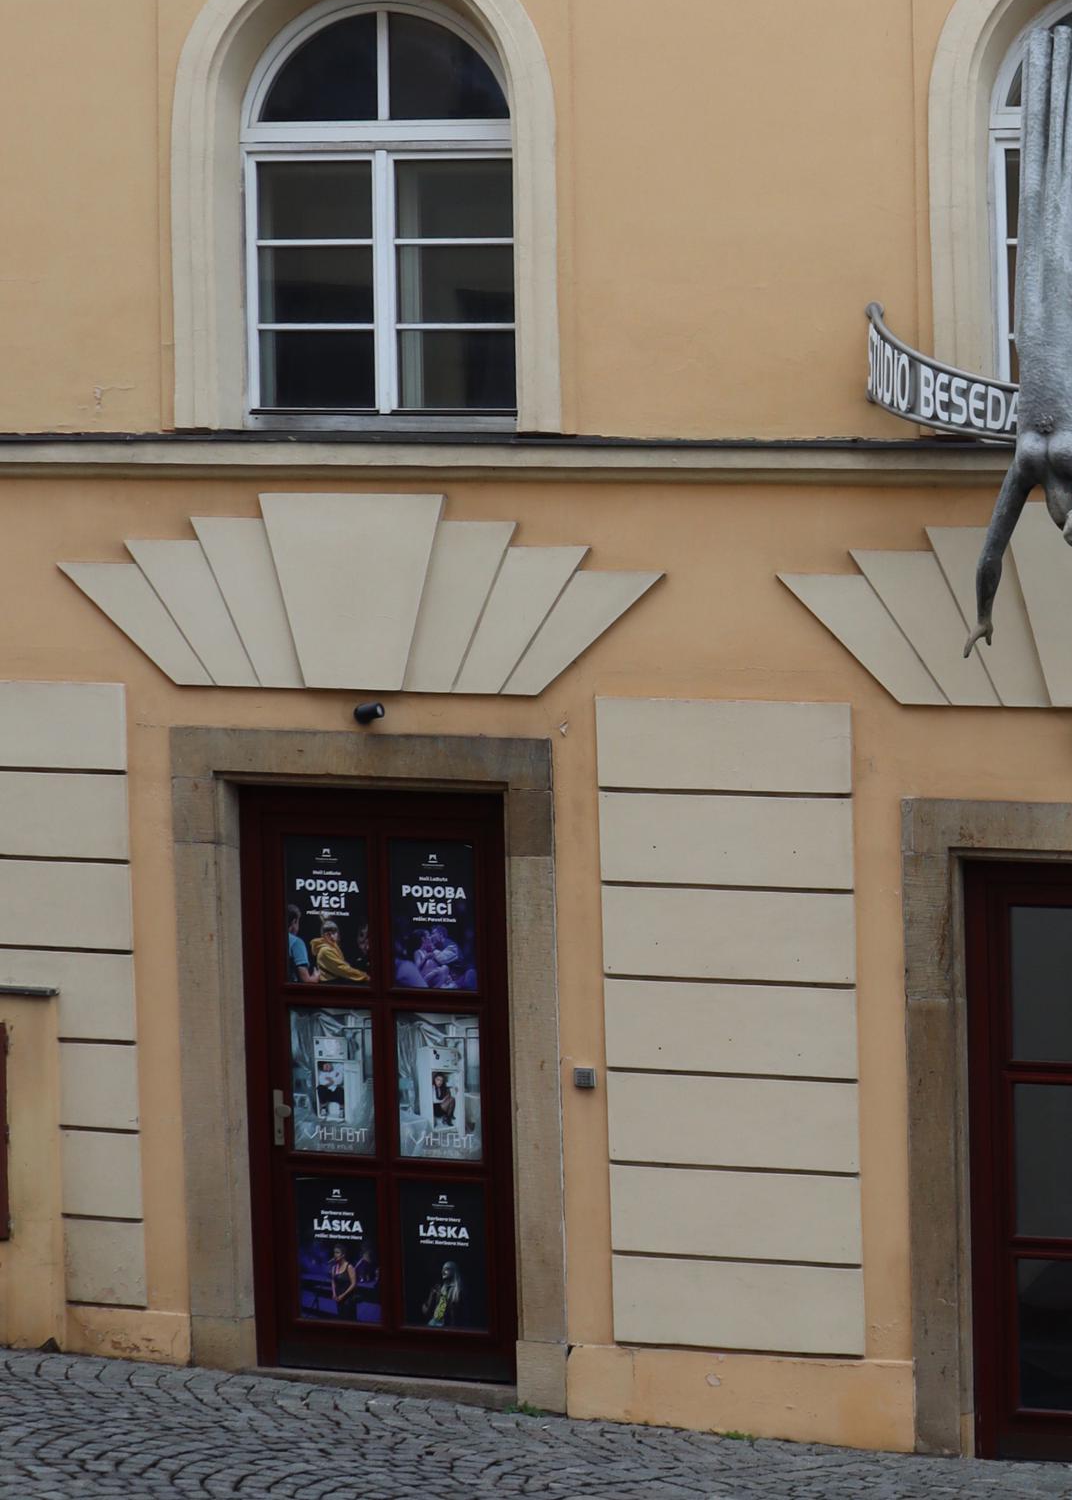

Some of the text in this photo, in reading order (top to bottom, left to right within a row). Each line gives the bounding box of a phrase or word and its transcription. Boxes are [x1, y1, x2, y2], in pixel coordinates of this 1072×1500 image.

[867, 323, 910, 412] STUDIO
[295, 878, 360, 893] PODOBA
[401, 884, 467, 899] PODOBA
[310, 892, 346, 909] VĚCÍ
[416, 899, 452, 915] VĚCÍ
[313, 1215, 363, 1232] LÁSKA
[419, 1221, 470, 1240] LÁSKA
